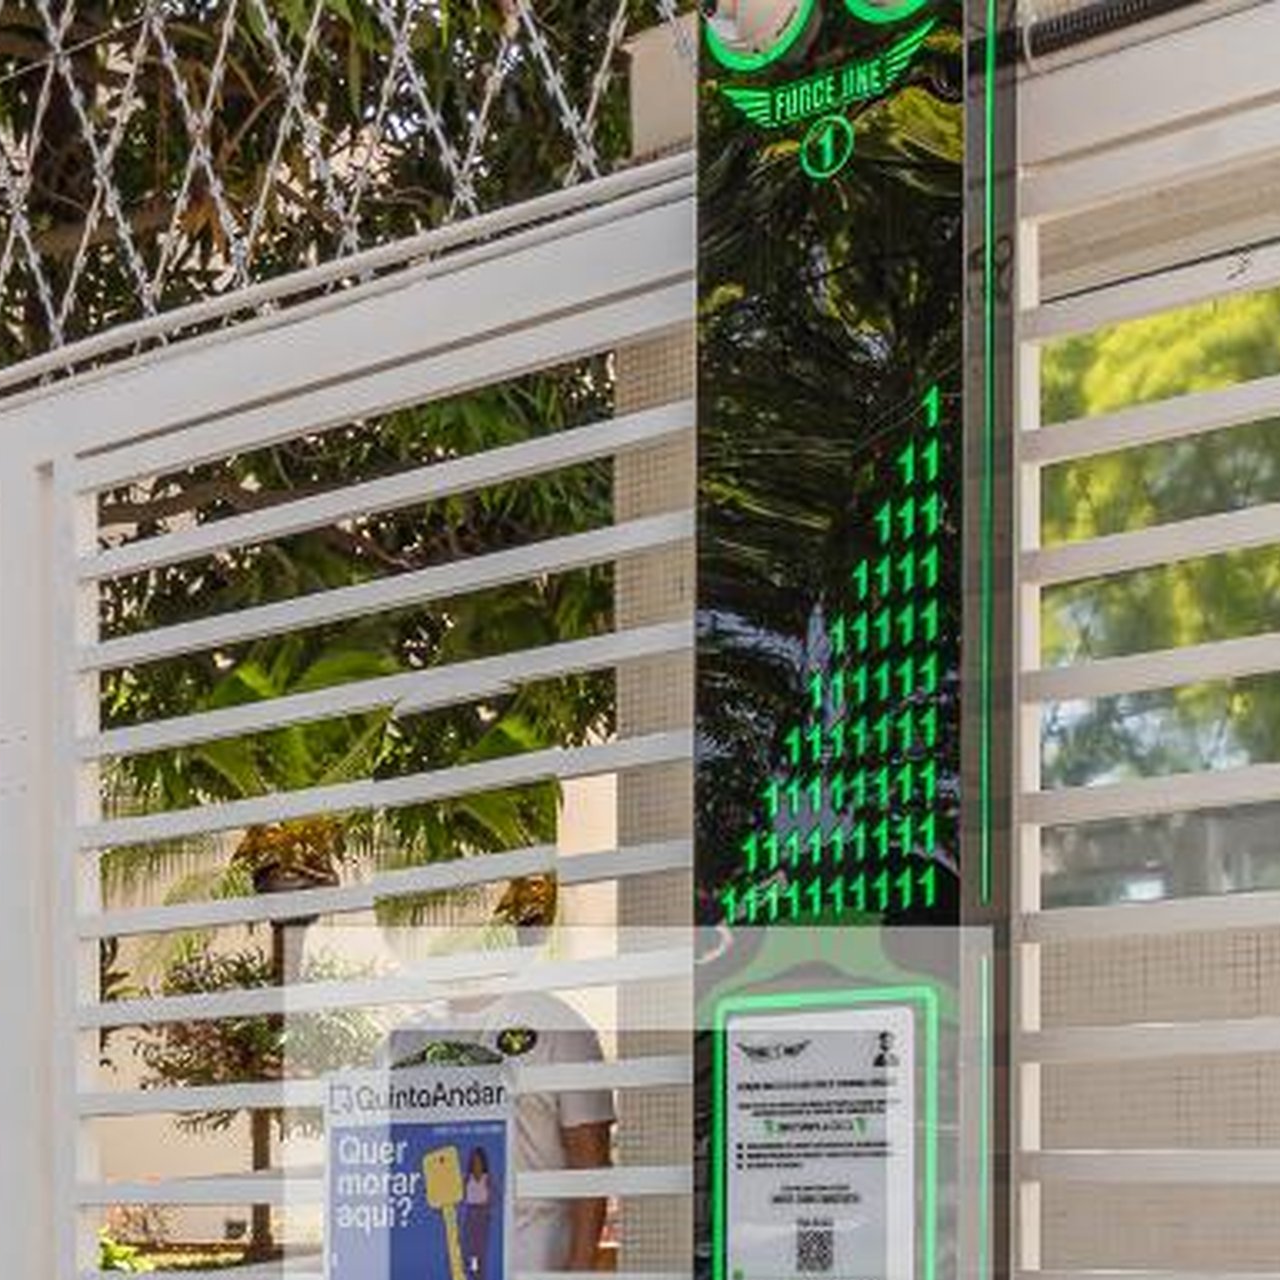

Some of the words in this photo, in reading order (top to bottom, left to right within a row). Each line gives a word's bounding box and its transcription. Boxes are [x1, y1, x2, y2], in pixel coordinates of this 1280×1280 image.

[355, 1081, 506, 1112] QuintoAndar
[338, 1134, 409, 1166] Quer
[337, 1172, 420, 1196] morar
[336, 1197, 413, 1237] aqui?
